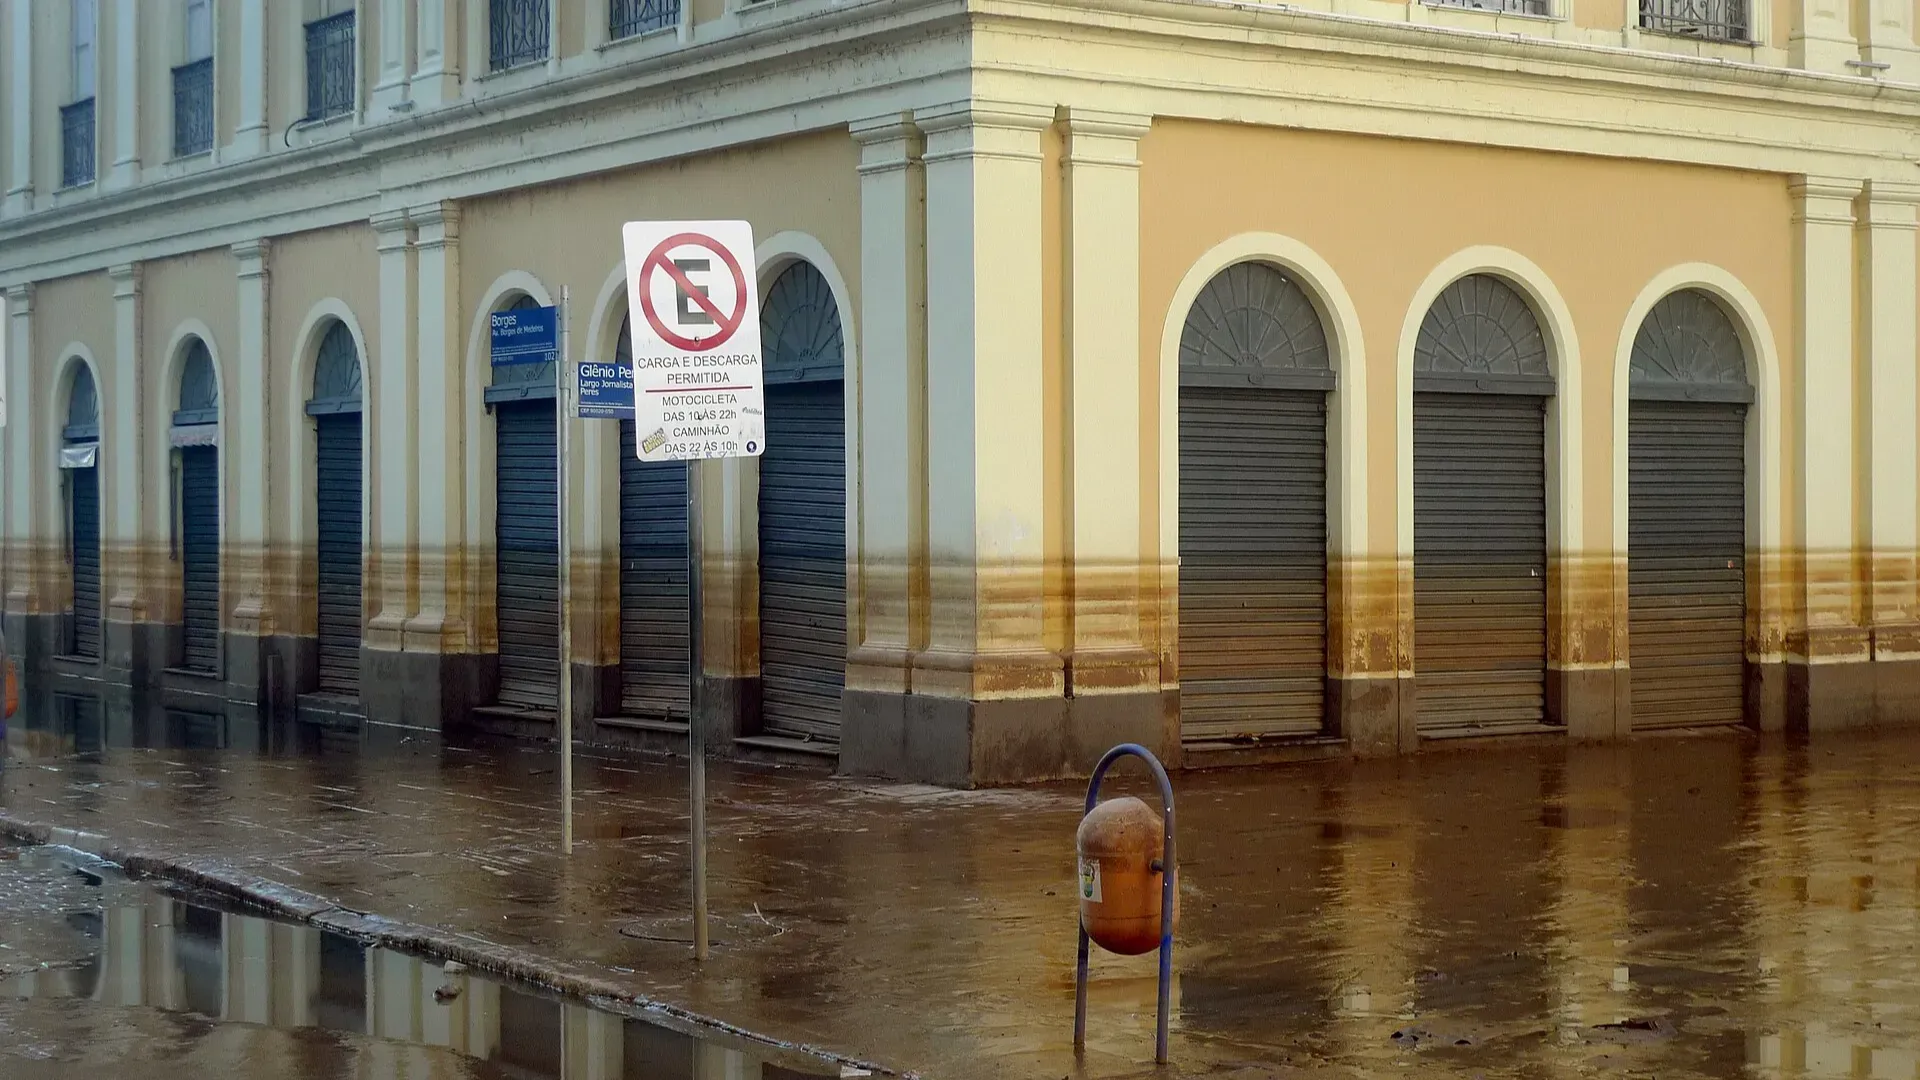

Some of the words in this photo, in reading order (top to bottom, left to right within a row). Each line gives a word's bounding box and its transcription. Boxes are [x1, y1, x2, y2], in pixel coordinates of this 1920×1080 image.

[674, 259, 714, 325] E
[492, 315, 517, 329] Borges
[500, 328, 516, 338] Borges
[516, 326, 523, 335] de
[523, 325, 544, 335] Medeiros
[638, 356, 680, 370] CARGA
[683, 356, 691, 367] E
[693, 354, 758, 367] DESCARGA
[580, 364, 615, 378] Glênio
[580, 379, 600, 388] Largo
[601, 380, 634, 389] Jornalista
[667, 372, 731, 385] PERMITIDA
[580, 388, 600, 396] Peres
[662, 394, 738, 407] MOTOCICLETA
[663, 411, 686, 422] DAS
[689, 411, 700, 421] 10
[702, 407, 717, 420] ÀS
[719, 409, 737, 420] 22h
[673, 423, 730, 438] CAMINHÃO
[664, 442, 687, 454] DAS
[689, 441, 701, 452] 22
[703, 439, 718, 452] ÀS
[721, 440, 738, 451] 10h
